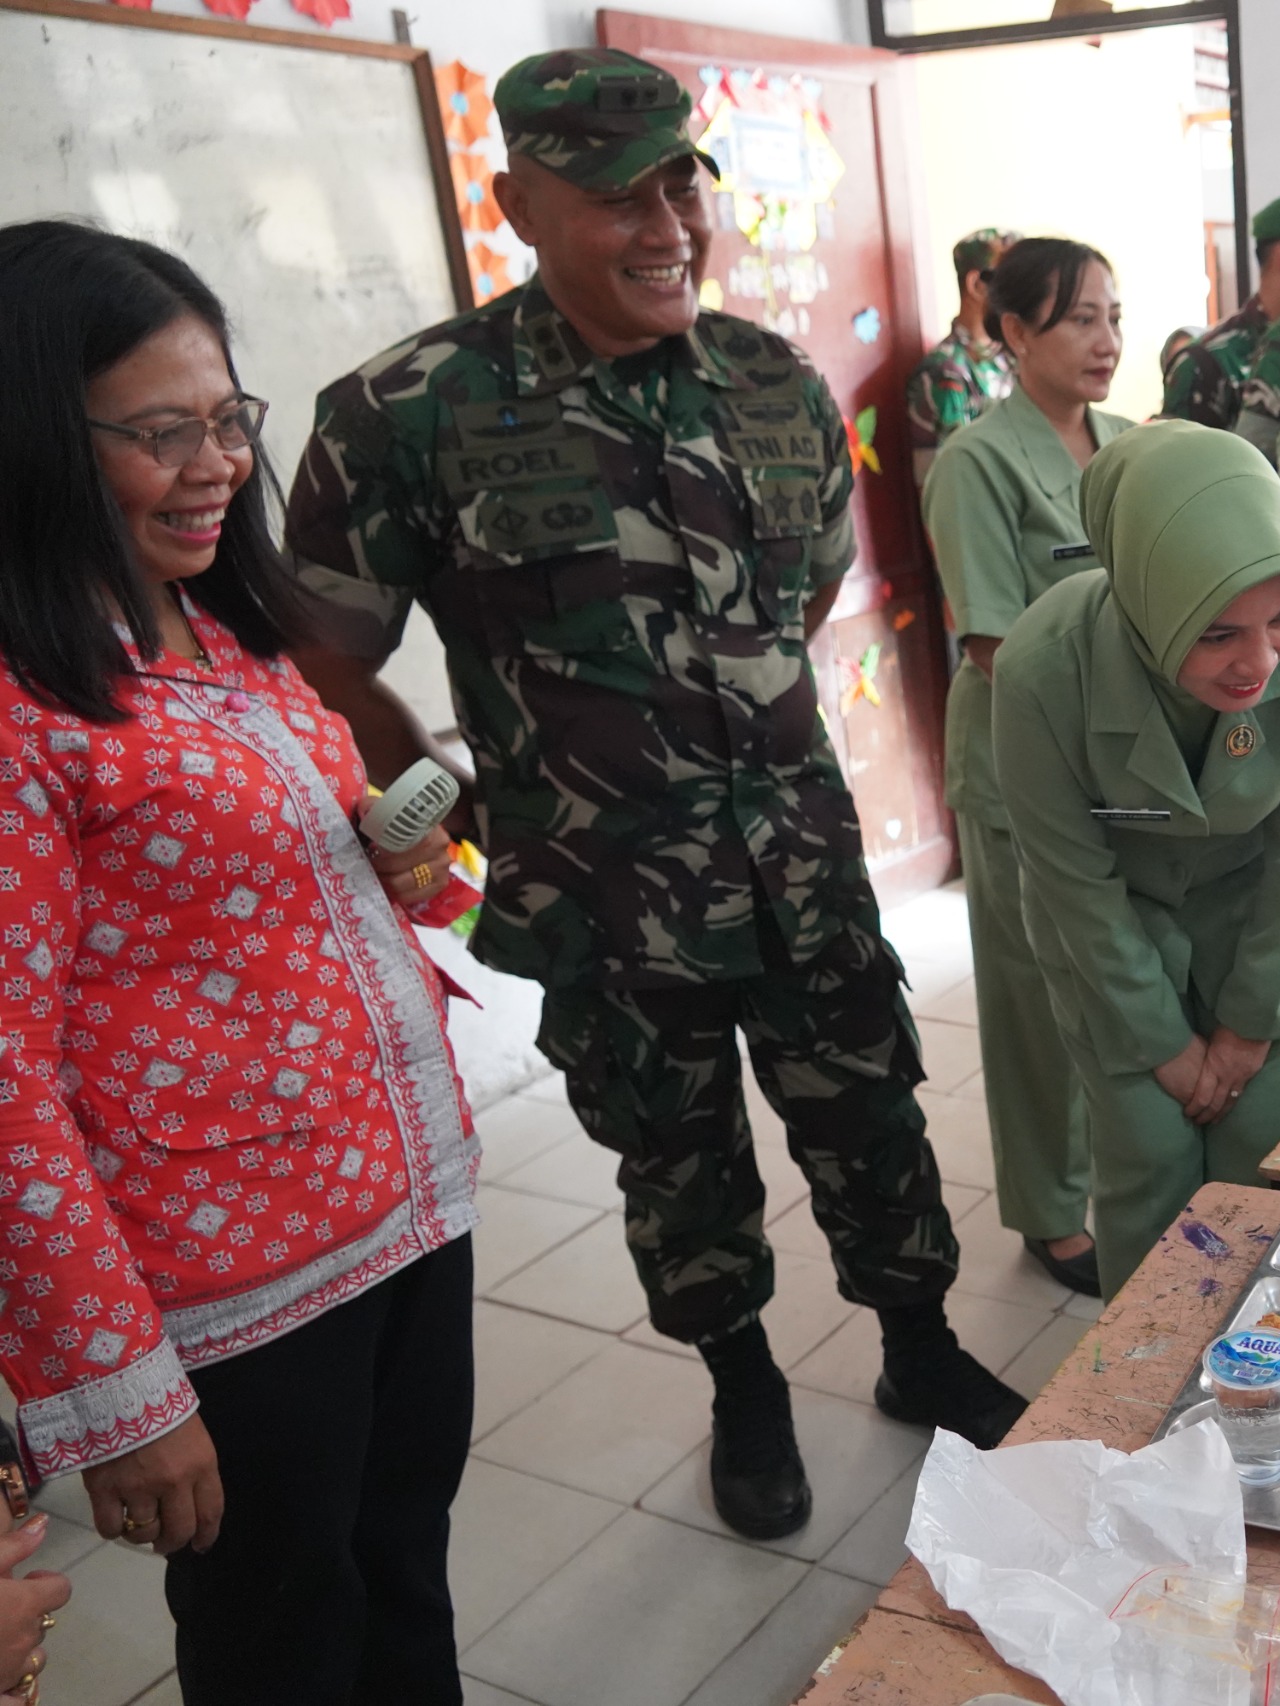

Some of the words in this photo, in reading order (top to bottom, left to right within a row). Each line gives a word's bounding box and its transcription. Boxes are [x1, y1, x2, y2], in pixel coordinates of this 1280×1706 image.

[736, 436, 784, 460] TNI
[790, 434, 817, 459] AD
[458, 448, 575, 483] ROEL
